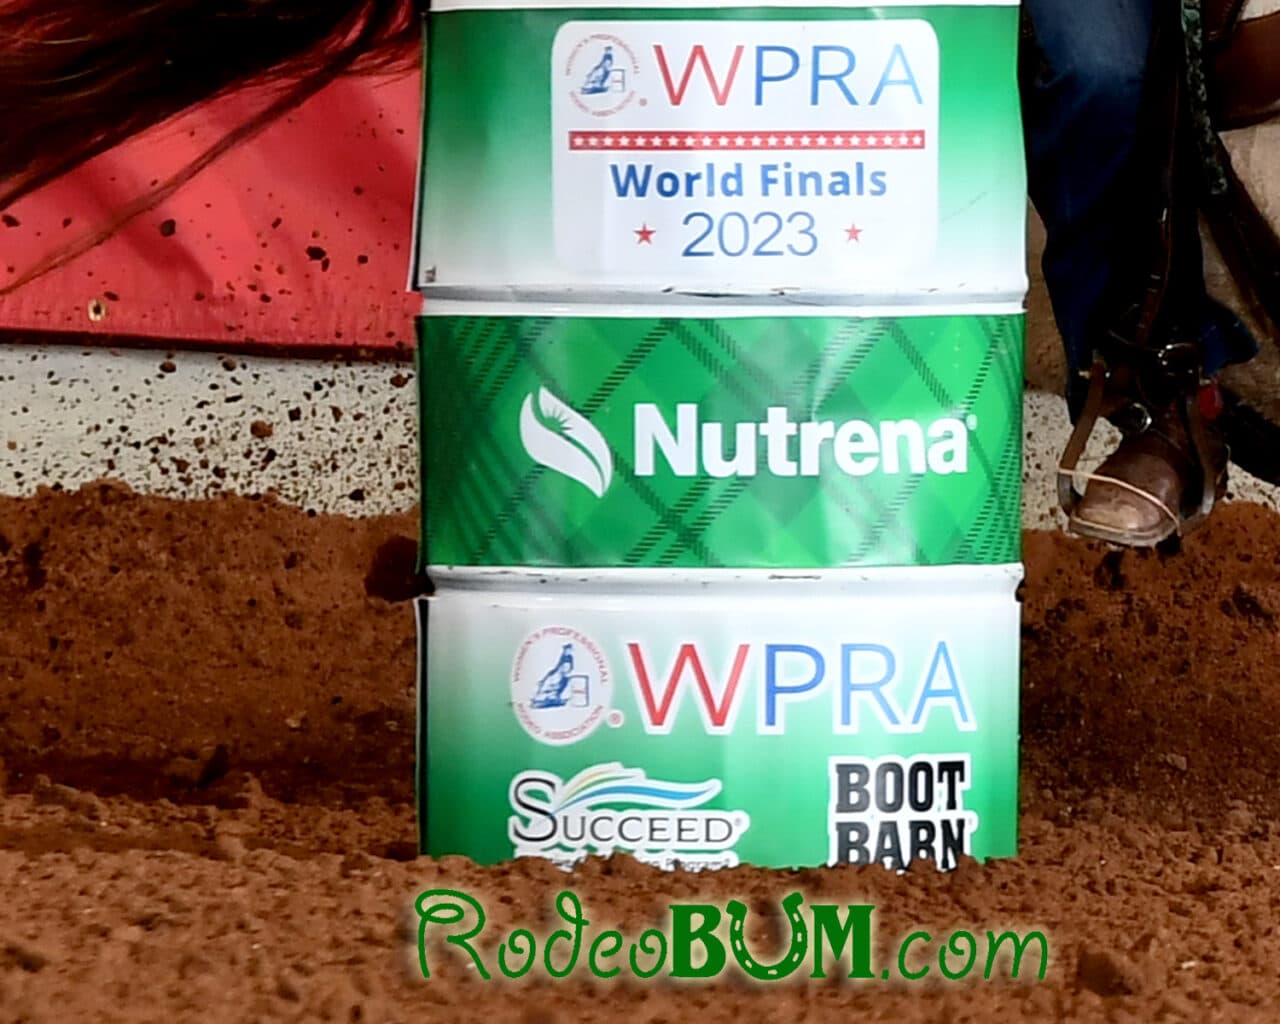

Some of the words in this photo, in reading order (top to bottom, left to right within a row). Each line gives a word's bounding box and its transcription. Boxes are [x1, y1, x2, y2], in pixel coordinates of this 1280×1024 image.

[652, 43, 924, 107] WPRA
[609, 162, 745, 199] World
[759, 161, 888, 198] Finals
[680, 211, 819, 258] 2023
[633, 402, 969, 478] Nutrena
[628, 640, 971, 727] WPRA
[835, 760, 965, 814] BOOT
[835, 818, 966, 869] BARN
